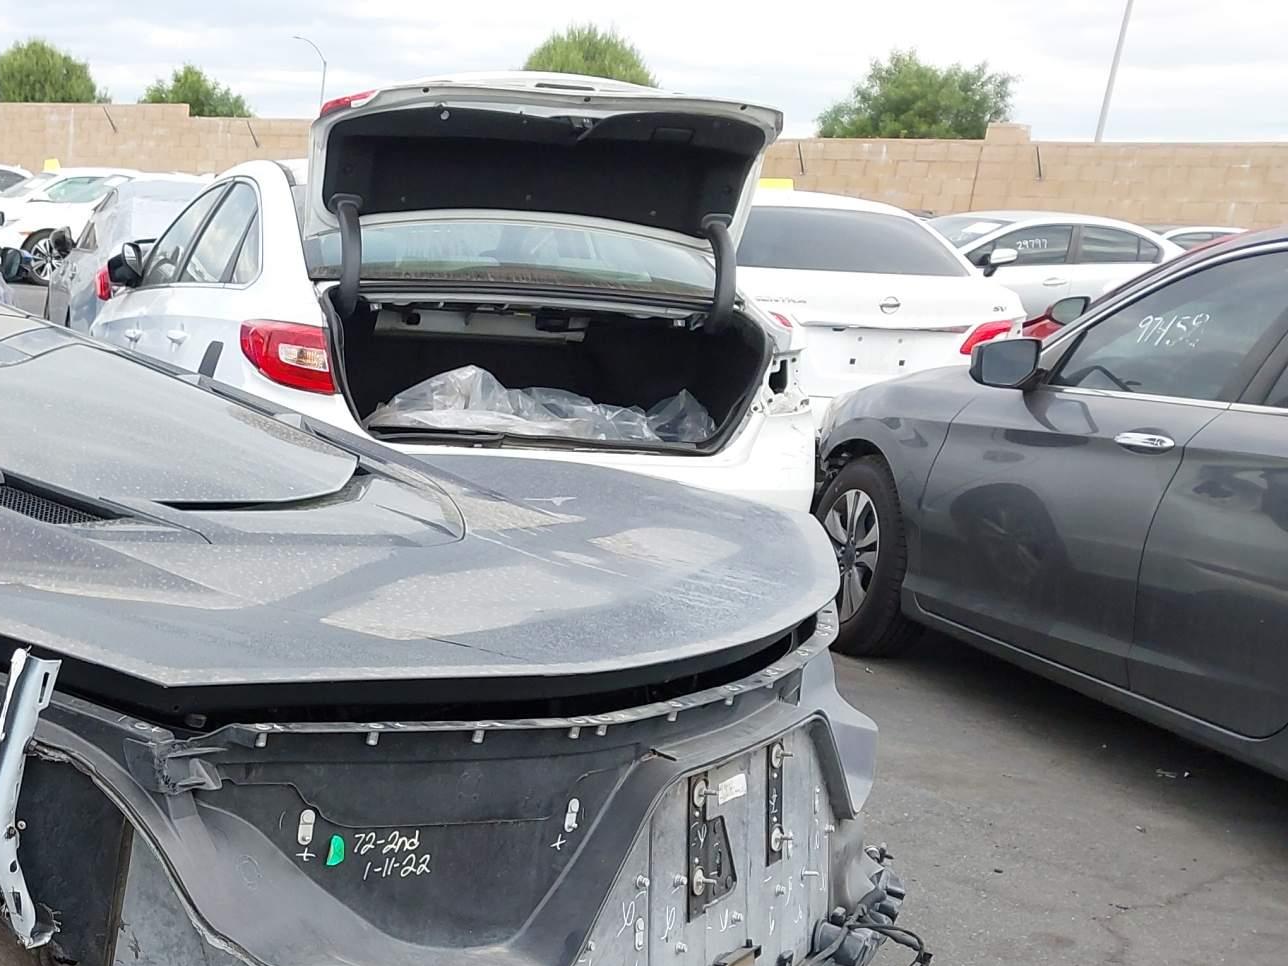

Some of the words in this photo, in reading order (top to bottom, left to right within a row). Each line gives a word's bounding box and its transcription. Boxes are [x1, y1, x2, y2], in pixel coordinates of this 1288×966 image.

[1016, 238, 1048, 250] 29797
[353, 829, 420, 855] 72-2nd
[362, 853, 431, 880] 1-11-22
